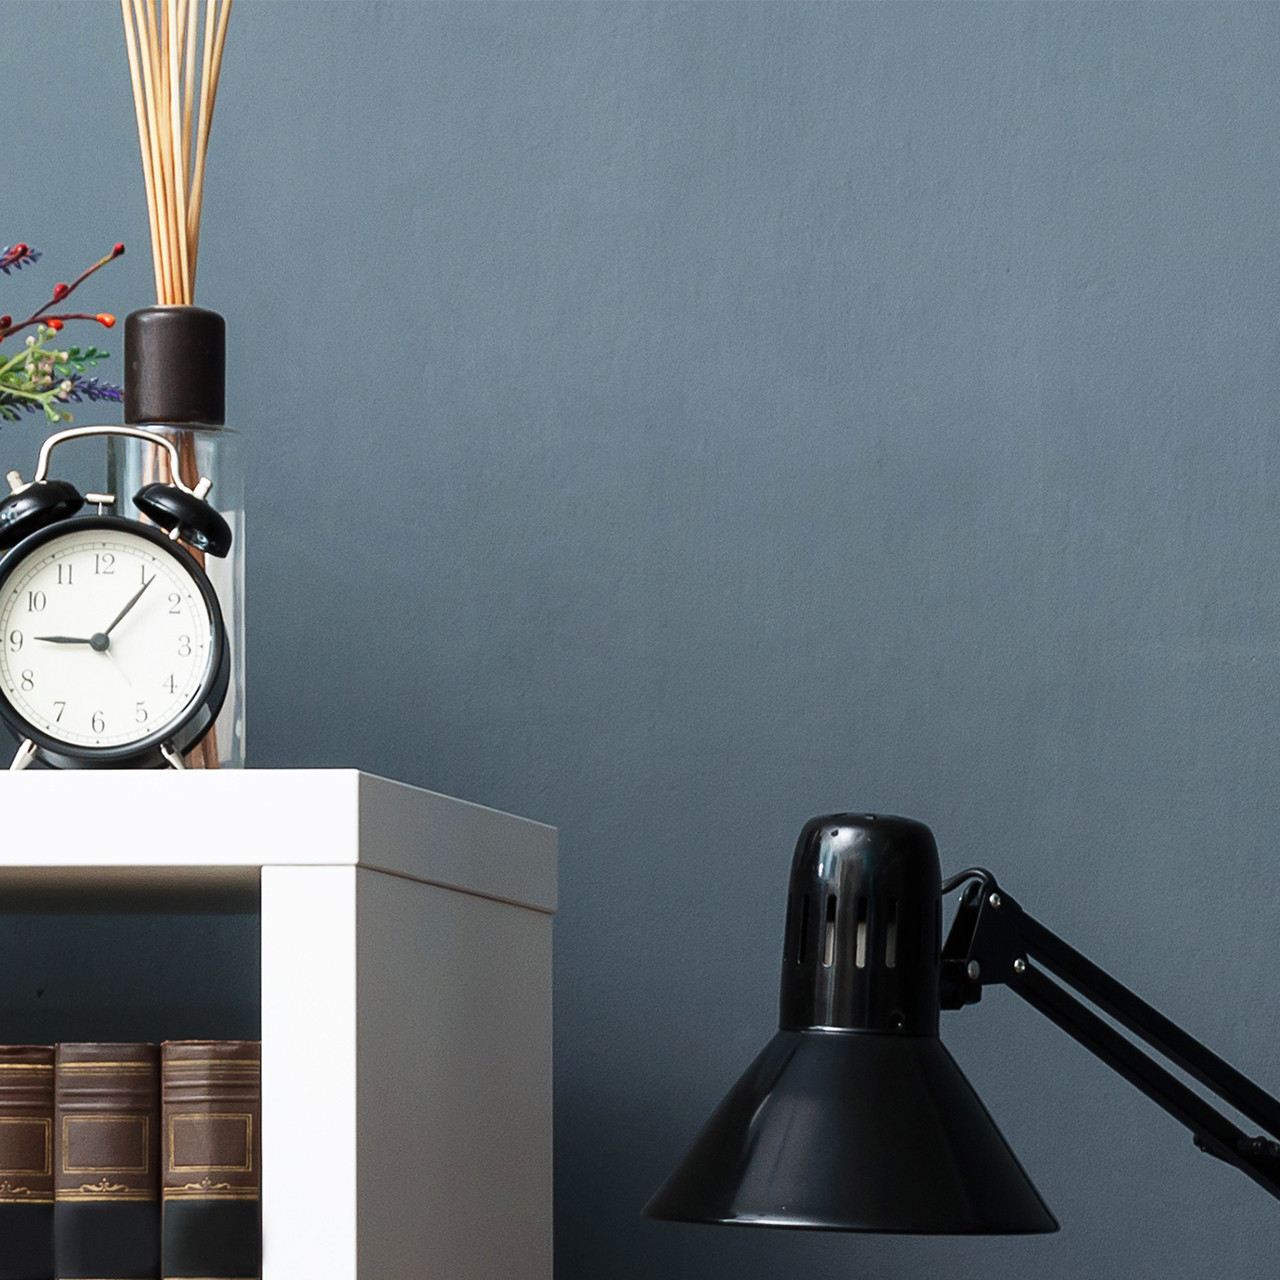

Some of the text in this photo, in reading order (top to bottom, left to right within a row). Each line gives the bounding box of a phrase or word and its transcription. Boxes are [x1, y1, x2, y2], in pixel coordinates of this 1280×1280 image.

[57, 563, 73, 585] 11
[94, 553, 115, 575] 12
[140, 564, 147, 585] 1
[27, 590, 47, 612] 10
[168, 592, 181, 614] 2
[10, 629, 23, 652] 9
[177, 634, 191, 657] 3
[20, 668, 34, 692] 8
[162, 673, 178, 694] 4
[53, 700, 66, 723] 7
[91, 711, 105, 734] 6
[136, 702, 148, 723] 5
